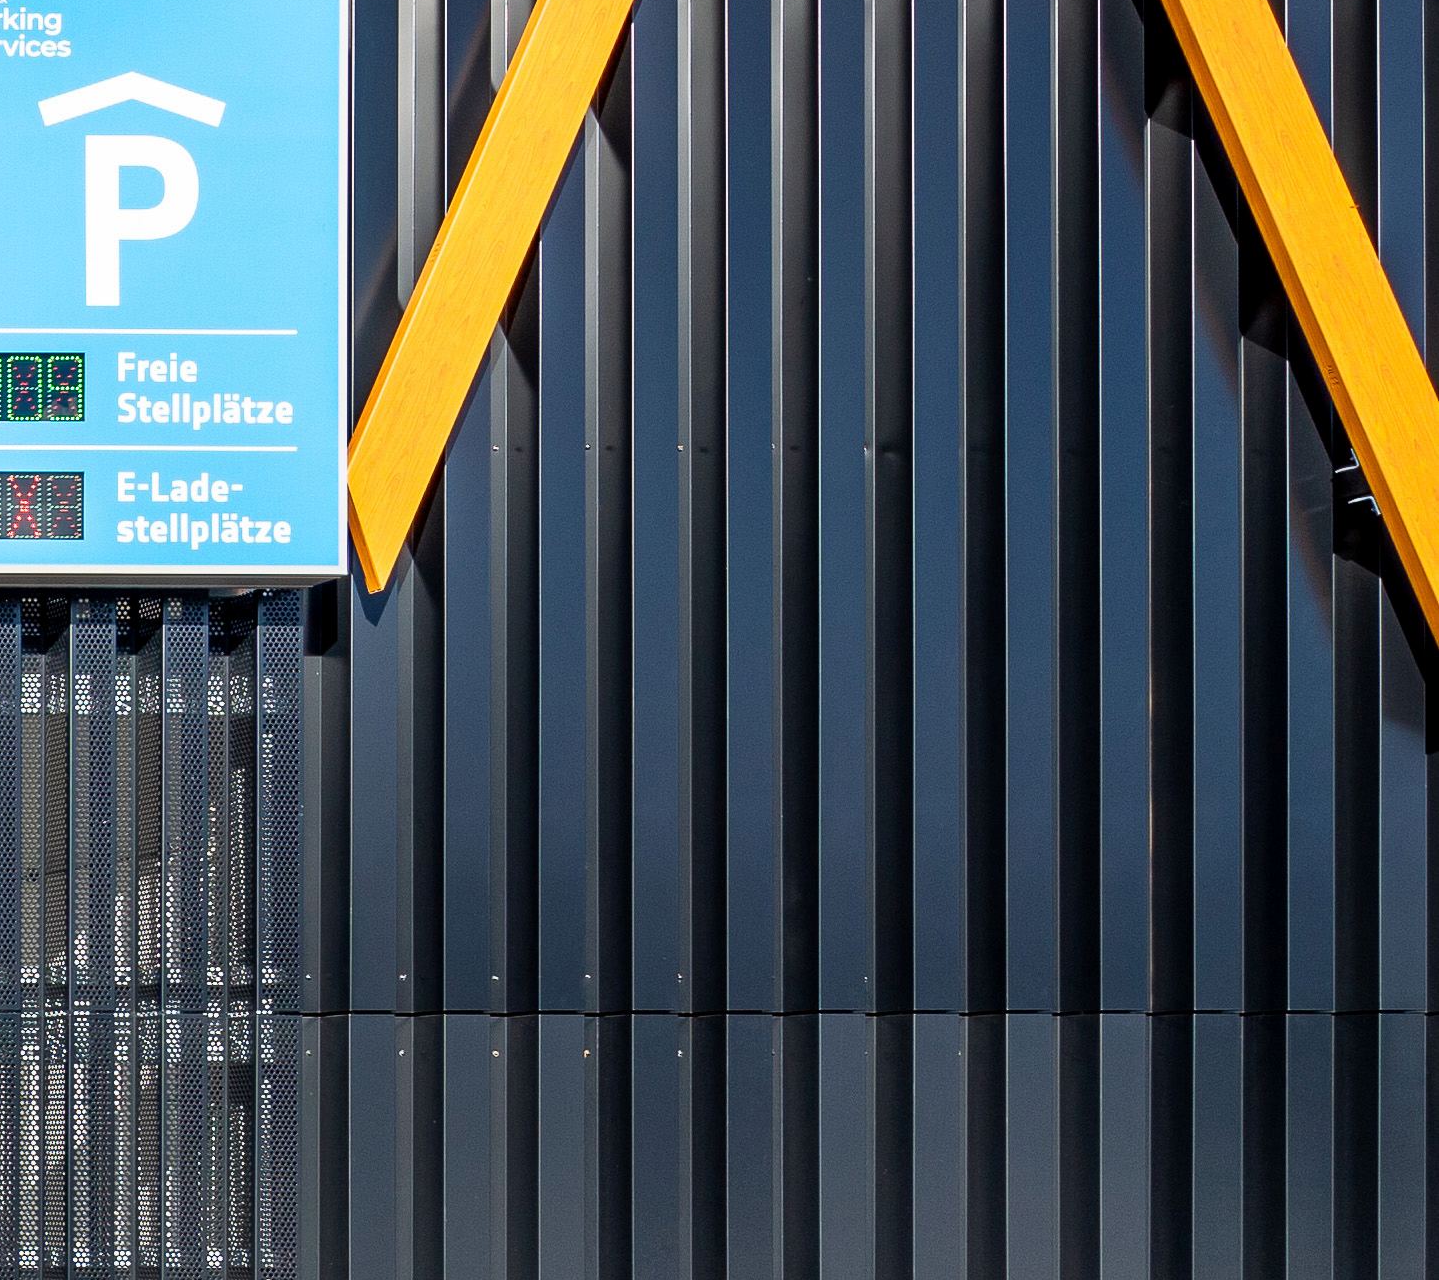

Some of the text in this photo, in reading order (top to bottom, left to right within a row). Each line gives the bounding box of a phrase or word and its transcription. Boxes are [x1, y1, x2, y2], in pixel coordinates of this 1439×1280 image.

[85, 134, 200, 307] P
[117, 352, 198, 382] Freie
[117, 392, 294, 431] Stellplätze
[117, 472, 244, 503] E-Lade-
[117, 513, 292, 550] stellplätze
